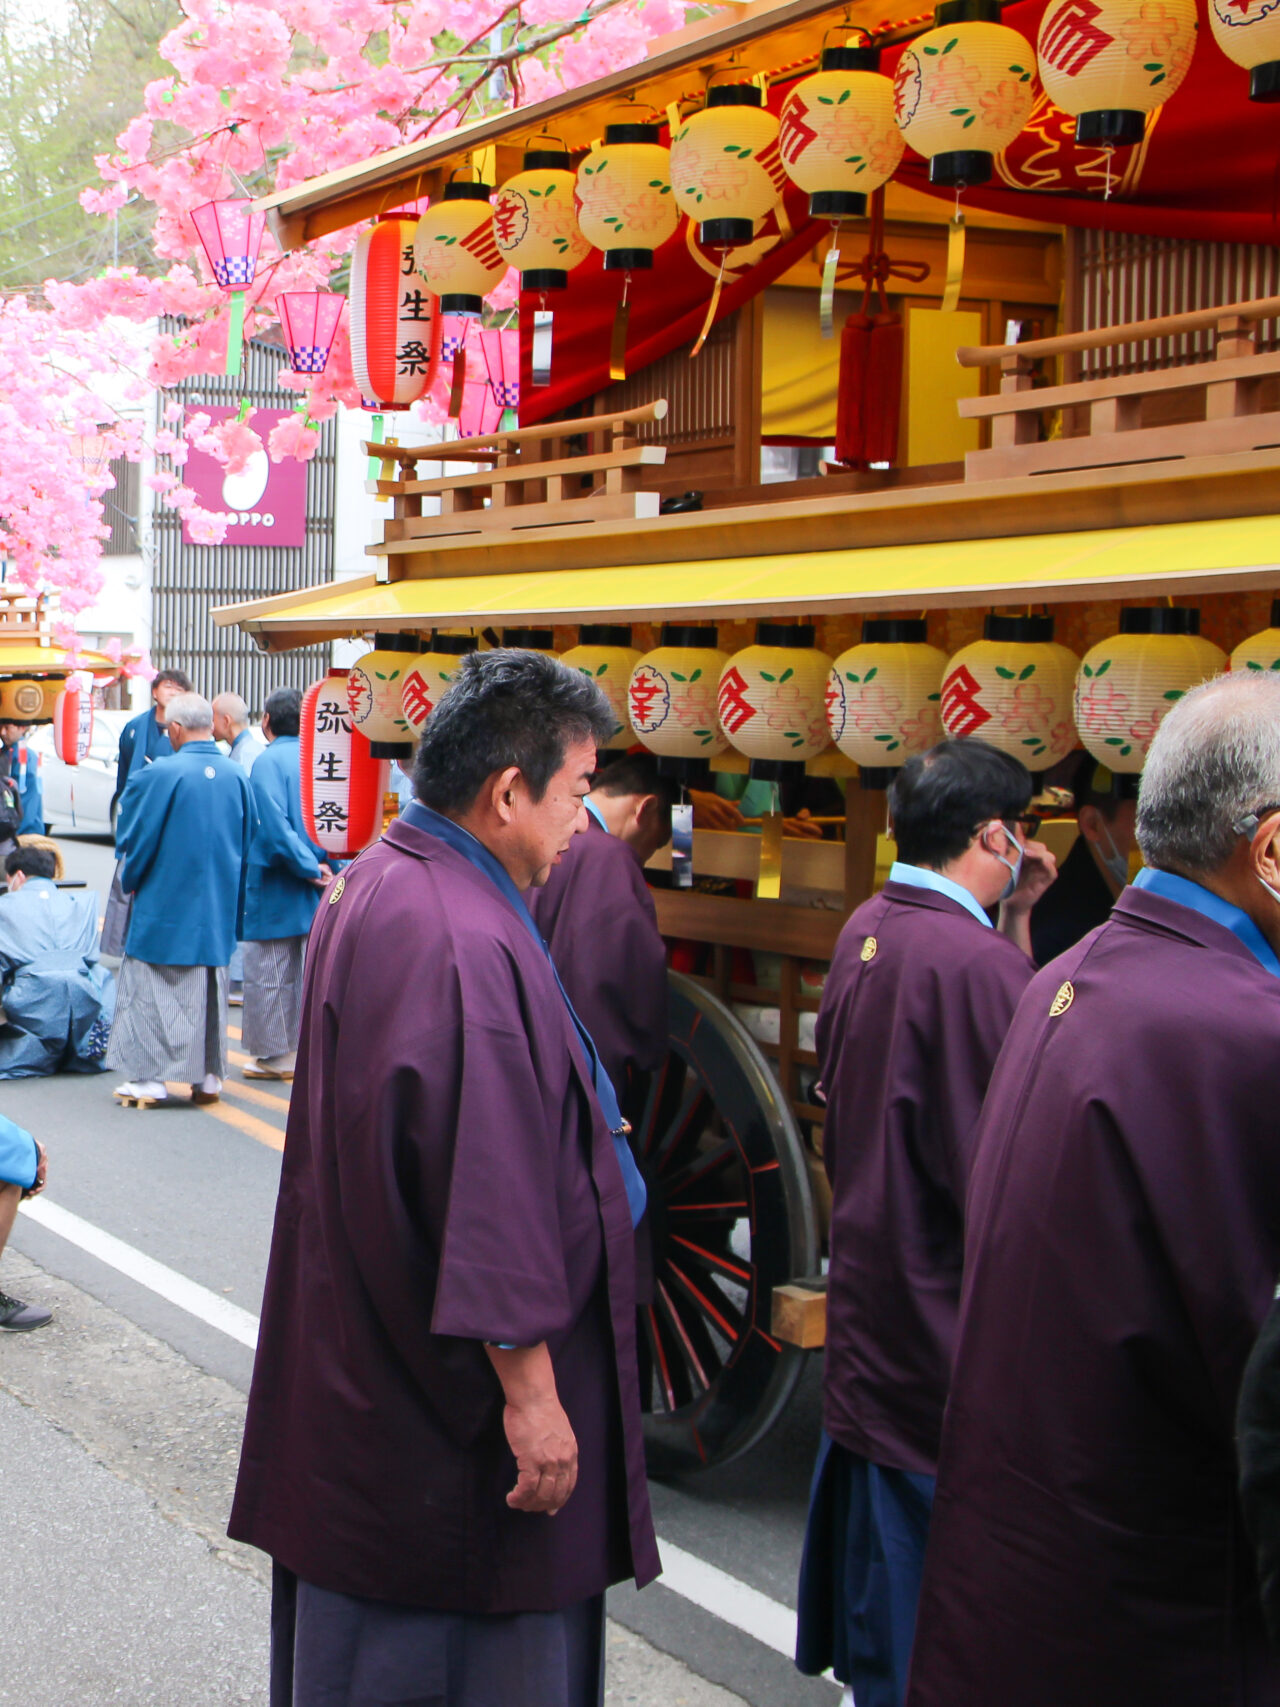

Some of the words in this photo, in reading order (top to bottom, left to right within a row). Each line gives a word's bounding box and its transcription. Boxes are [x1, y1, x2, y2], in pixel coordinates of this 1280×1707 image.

[222, 511, 275, 527] OPPO
[314, 701, 354, 833] 弥生祭
